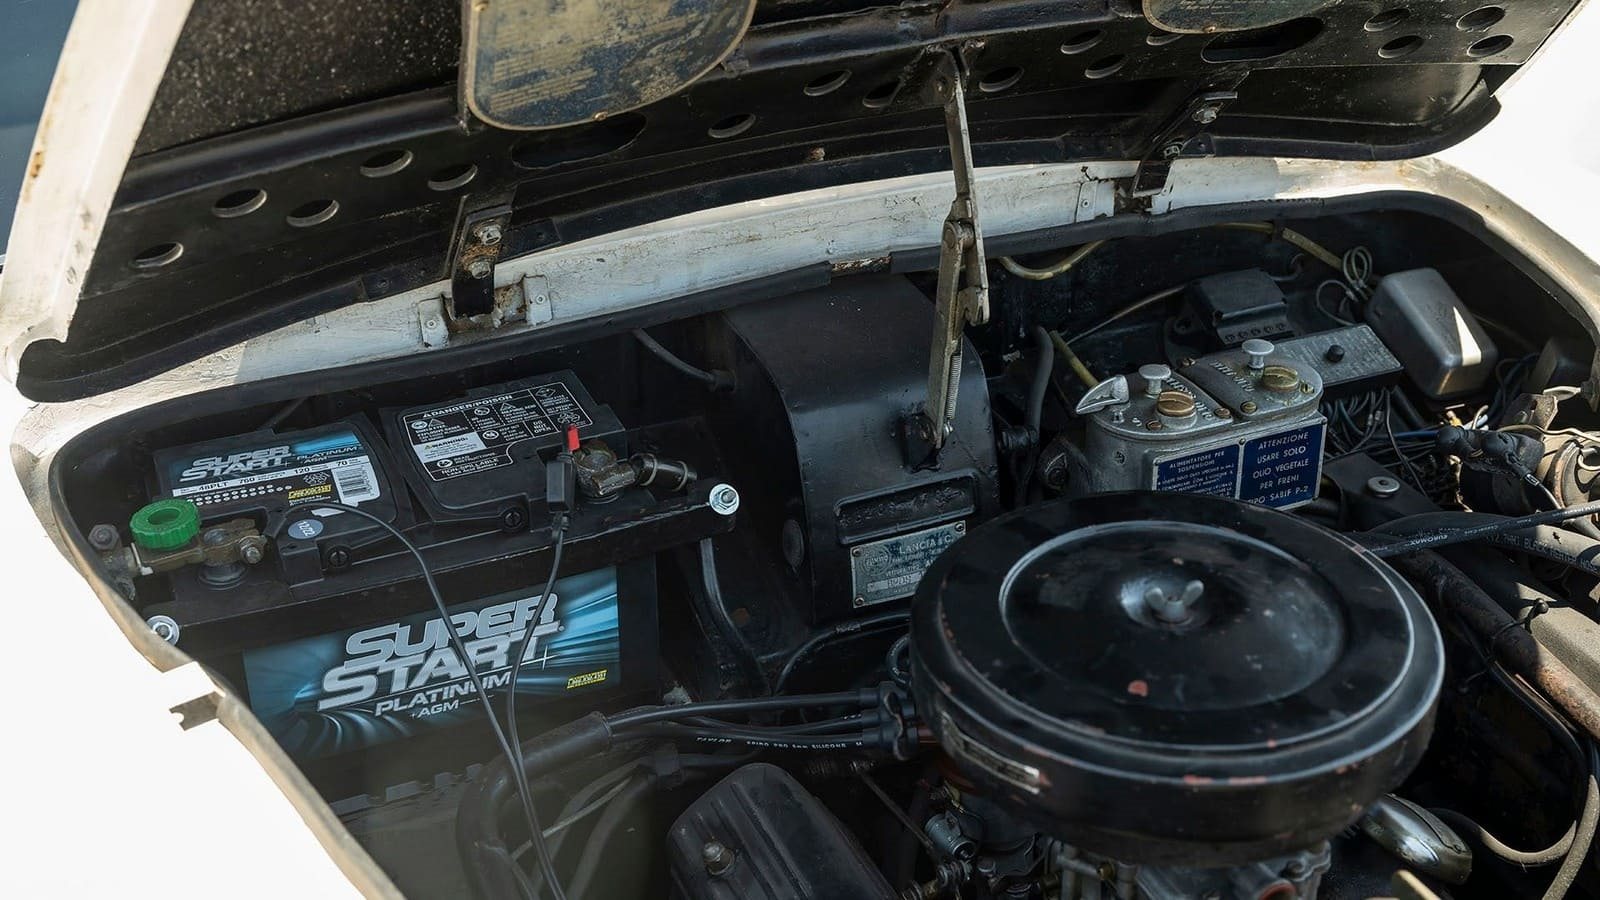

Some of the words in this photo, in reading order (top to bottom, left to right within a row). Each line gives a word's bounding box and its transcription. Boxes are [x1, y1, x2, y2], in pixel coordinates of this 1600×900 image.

[1258, 432, 1309, 450] ATTENZIONE
[193, 445, 290, 467] SUPER
[297, 446, 357, 460] PLATINUM
[1169, 454, 1212, 469] ALIMENTATORE
[1214, 450, 1225, 458] PER
[1257, 452, 1280, 464] USARE
[1283, 445, 1306, 457] SOLO
[180, 453, 292, 482] START
[1252, 467, 1271, 479] OLIO
[1275, 458, 1309, 472] VEGETALE
[1260, 480, 1273, 490] PER
[1277, 474, 1299, 485] FRENI
[900, 538, 936, 554] LANCIA
[1410, 534, 1448, 546] EUROMAX
[345, 593, 558, 657] SUPER
[318, 620, 562, 711] START
[375, 672, 511, 717] PLATINUM
[417, 701, 460, 719] AGM
